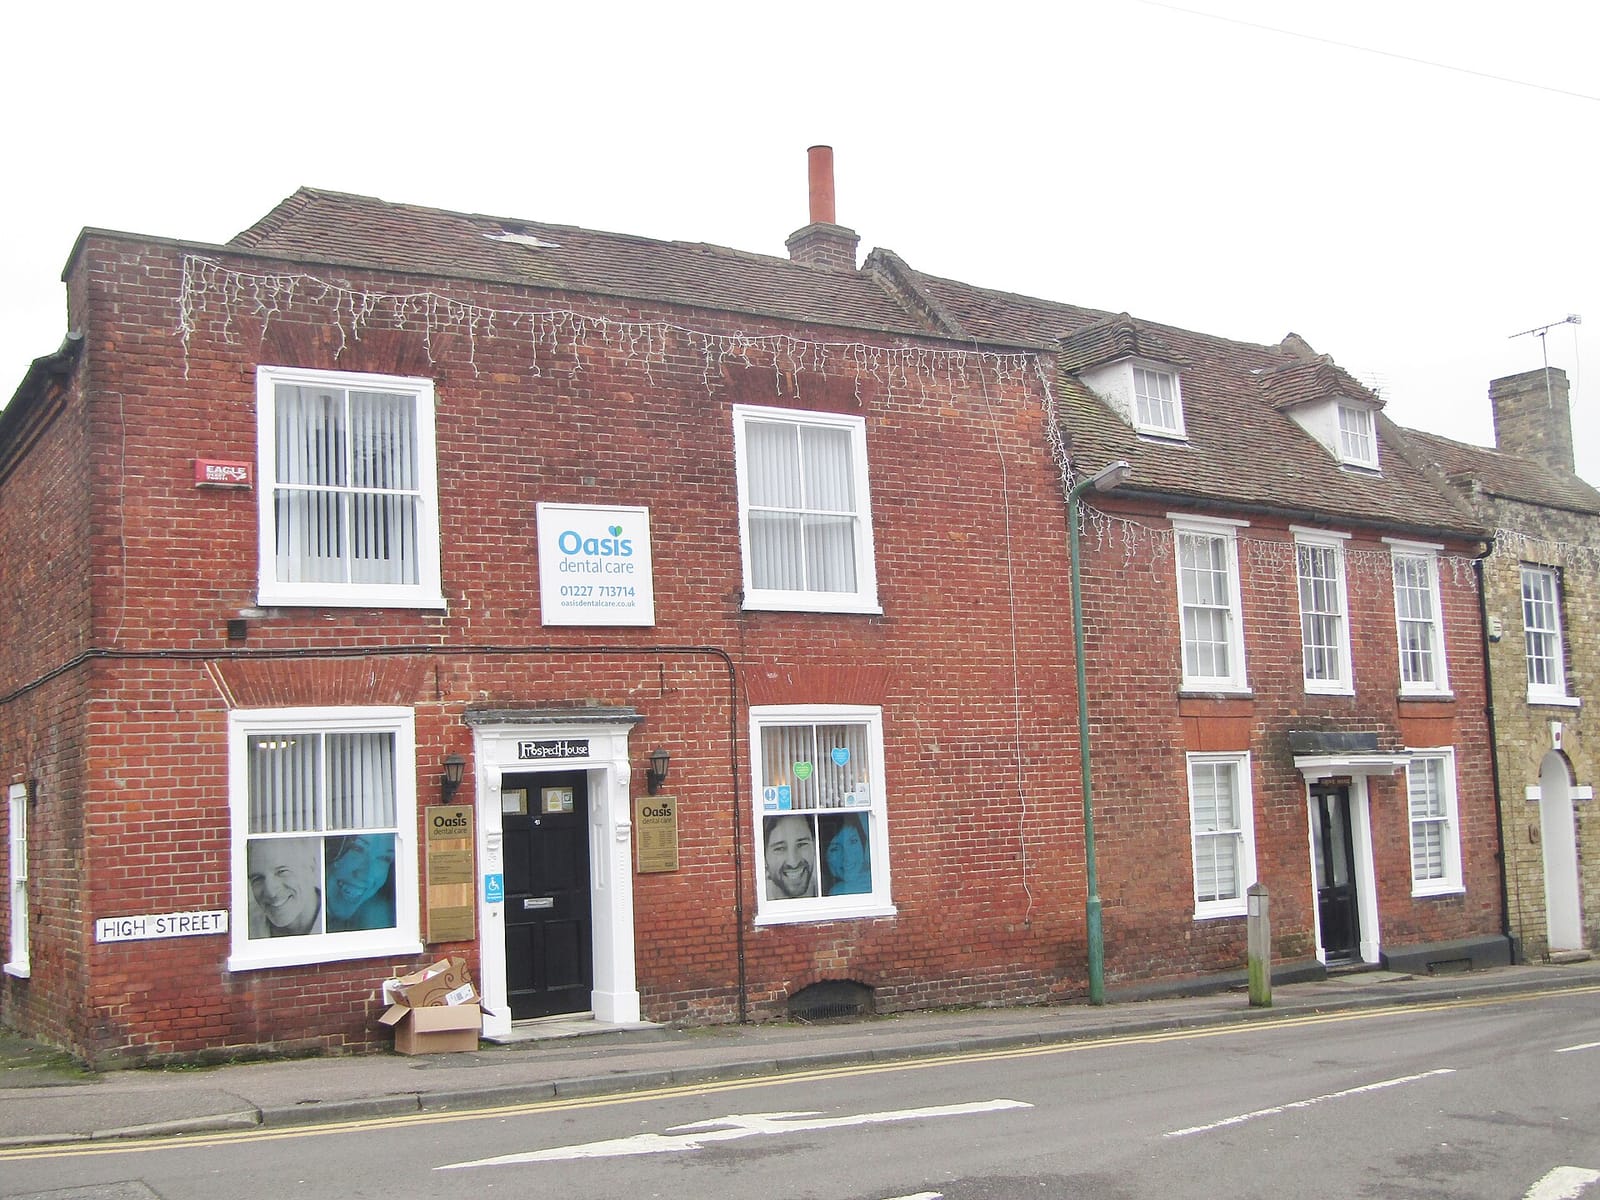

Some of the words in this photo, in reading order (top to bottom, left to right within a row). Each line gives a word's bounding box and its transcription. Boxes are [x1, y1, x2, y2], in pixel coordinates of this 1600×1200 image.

[206, 465, 246, 474] EAGLE
[558, 526, 633, 556] Oasis
[559, 557, 603, 574] dental
[605, 561, 634, 574] care
[560, 585, 593, 597] 01227
[598, 586, 636, 597] 713714
[560, 599, 636, 608] oasisdentalcare.co.uk
[642, 803, 672, 817] Oasis
[433, 813, 467, 828] Oasis
[433, 827, 454, 836] dental
[103, 920, 145, 937] HIGH
[156, 914, 221, 933] STREET
